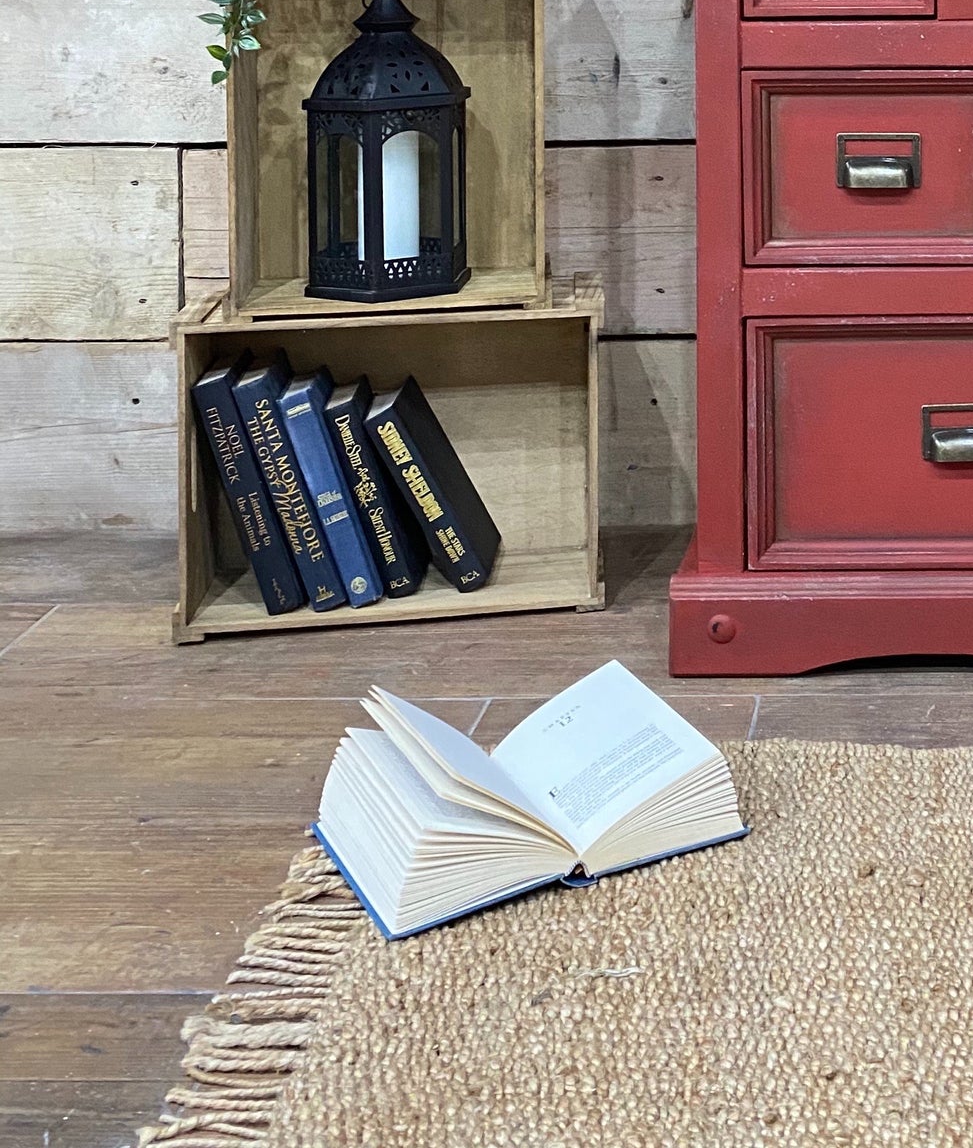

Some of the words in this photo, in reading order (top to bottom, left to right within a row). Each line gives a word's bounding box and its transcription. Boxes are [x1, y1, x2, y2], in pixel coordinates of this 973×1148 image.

[206, 406, 240, 485] FITZPATRICK
[225, 424, 245, 458] NOEL
[247, 416, 264, 445] THE
[257, 446, 281, 488] GYPSY
[255, 398, 284, 452] SANTA
[276, 454, 325, 563] MONTEFIORE
[377, 420, 413, 466] SIDNEY
[401, 464, 444, 523] SHELDON
[236, 496, 246, 512] the
[241, 514, 260, 552] Animals
[248, 491, 268, 536] Listening
[263, 536, 271, 547] to
[272, 480, 303, 555] Madonna
[445, 525, 457, 540] THE
[451, 535, 466, 557] STARS
[389, 576, 410, 590] BCA
[460, 570, 480, 585] BCA
